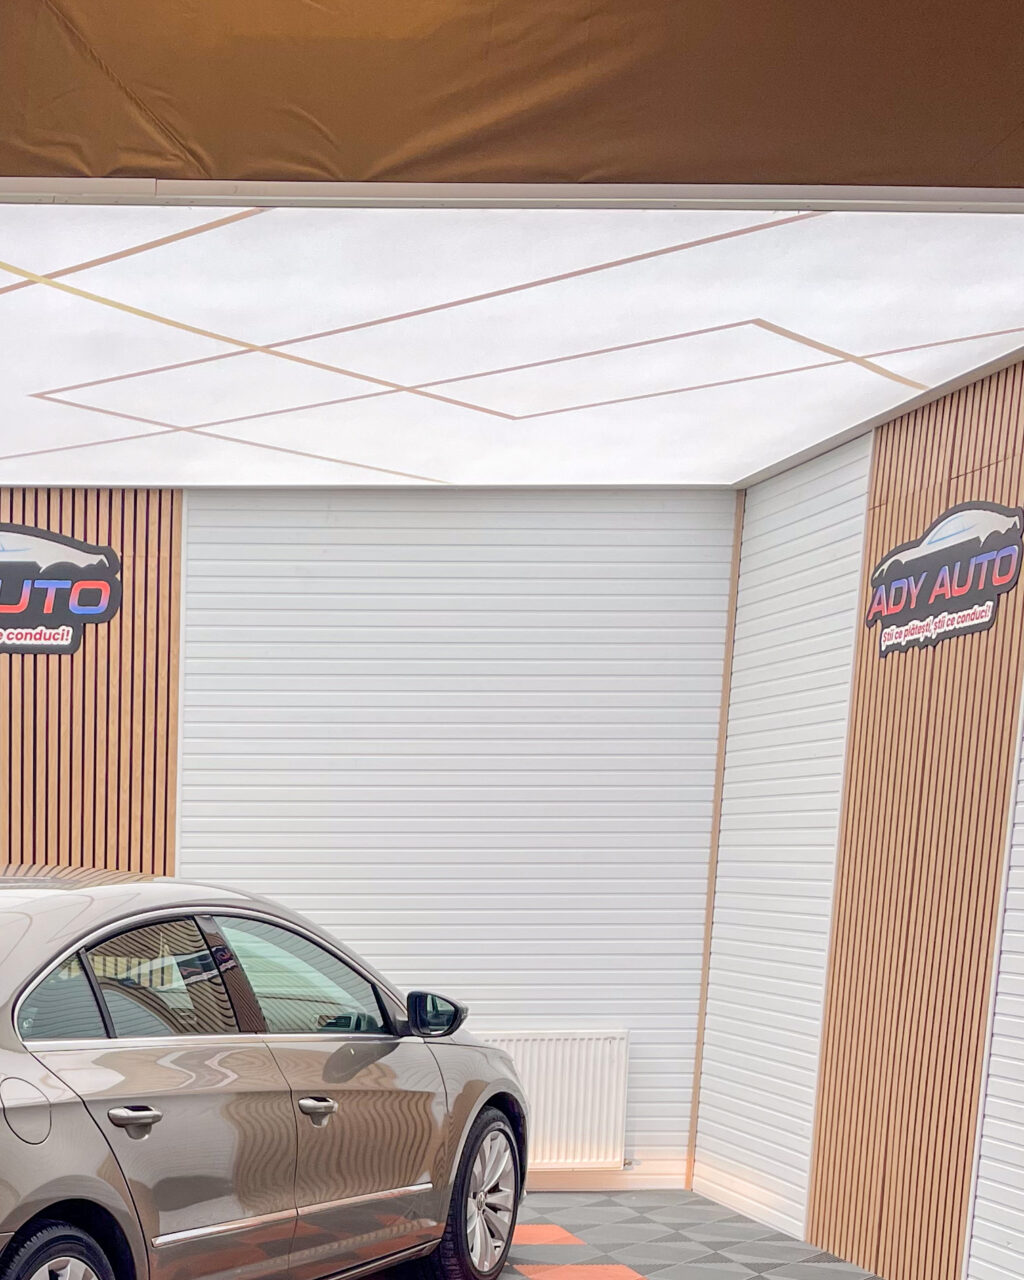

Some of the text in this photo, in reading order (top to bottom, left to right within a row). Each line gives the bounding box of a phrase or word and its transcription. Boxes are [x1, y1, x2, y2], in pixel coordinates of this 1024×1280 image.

[868, 545, 1019, 620] ADY AUTO
[6, 628, 70, 641] conduci!
[895, 630, 902, 640] ce
[946, 617, 955, 627] ce
